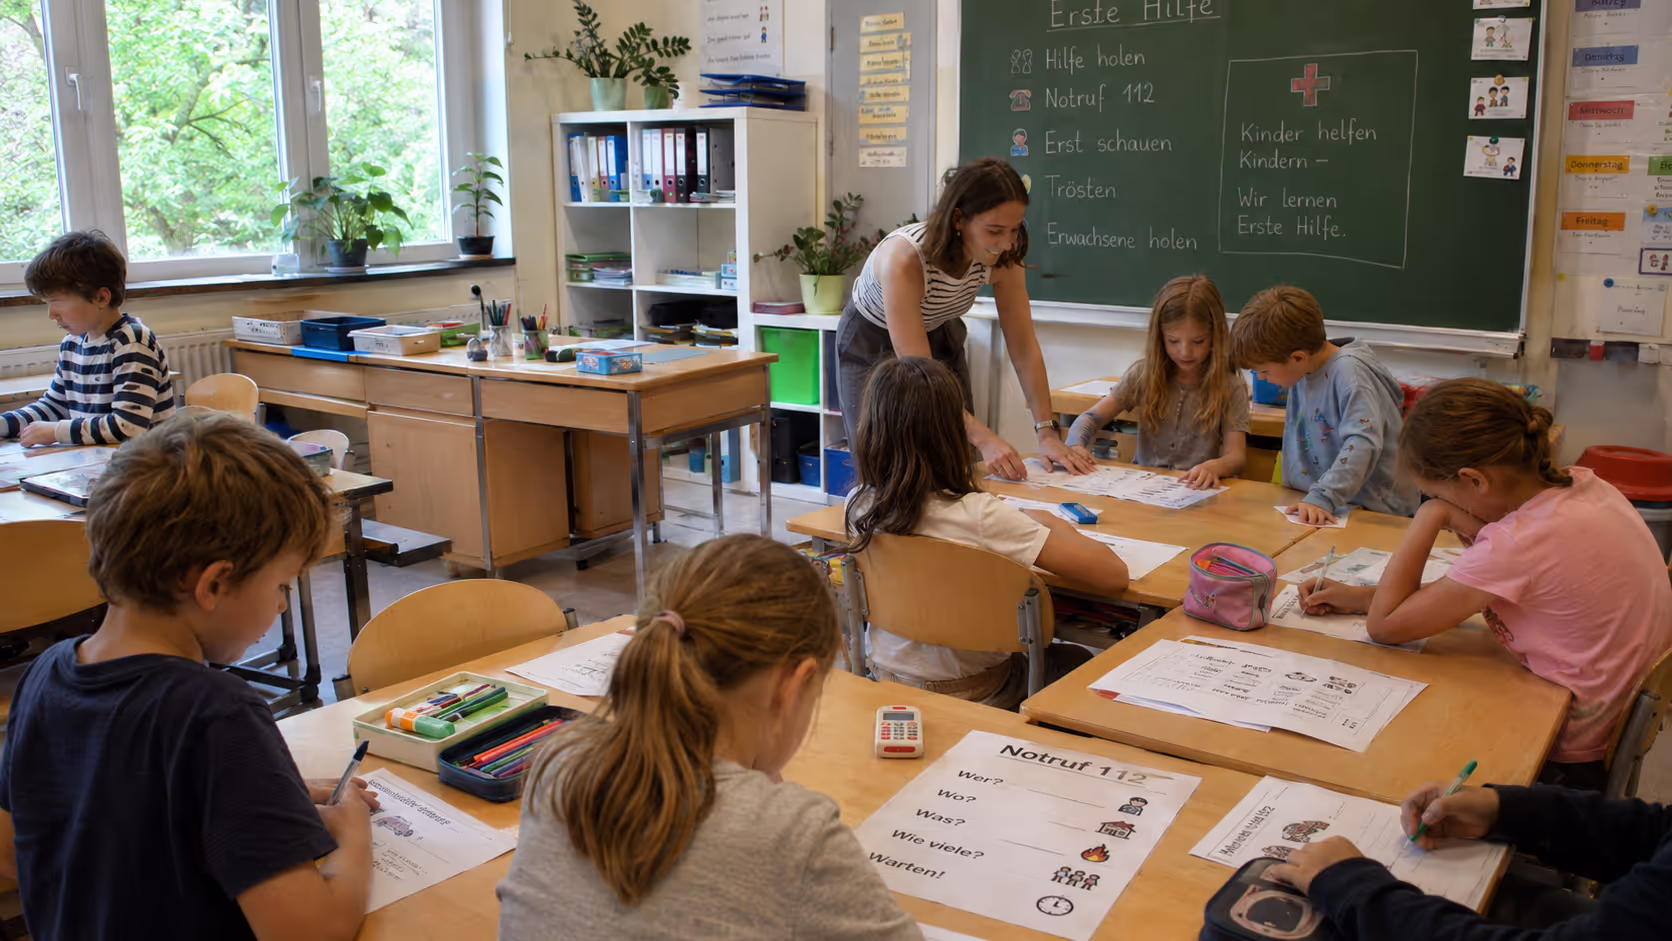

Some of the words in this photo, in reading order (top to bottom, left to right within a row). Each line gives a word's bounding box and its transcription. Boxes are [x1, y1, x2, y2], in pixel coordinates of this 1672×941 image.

[1051, 0, 1120, 27] Erste
[1046, 46, 1085, 75] Hilfe
[1097, 44, 1146, 67] holen
[1046, 83, 1106, 112] Notruf
[1122, 82, 1155, 103] 112
[1045, 130, 1083, 154] Erst
[1097, 128, 1173, 152] schauen
[1241, 120, 1304, 144] Kinder
[1318, 118, 1377, 145] helfen
[1239, 148, 1308, 169] Kindern
[1570, 160, 1623, 171] Donnerstag
[1045, 174, 1116, 199] Trösten
[1238, 187, 1268, 208] Wir
[1282, 187, 1337, 208] lernen
[1047, 222, 1136, 249] Erwachsene
[1149, 226, 1198, 250] holen
[1238, 215, 1283, 235] Erste
[1296, 215, 1347, 241] Hilfe.
[957, 770, 1004, 785] Wer?
[999, 744, 1093, 771] Notruf
[1099, 765, 1147, 785] 112
[937, 789, 977, 803] Wo?
[916, 808, 966, 826] Was?
[891, 829, 925, 845] Wie
[929, 840, 985, 860] viele?
[868, 851, 946, 879] Warten!
